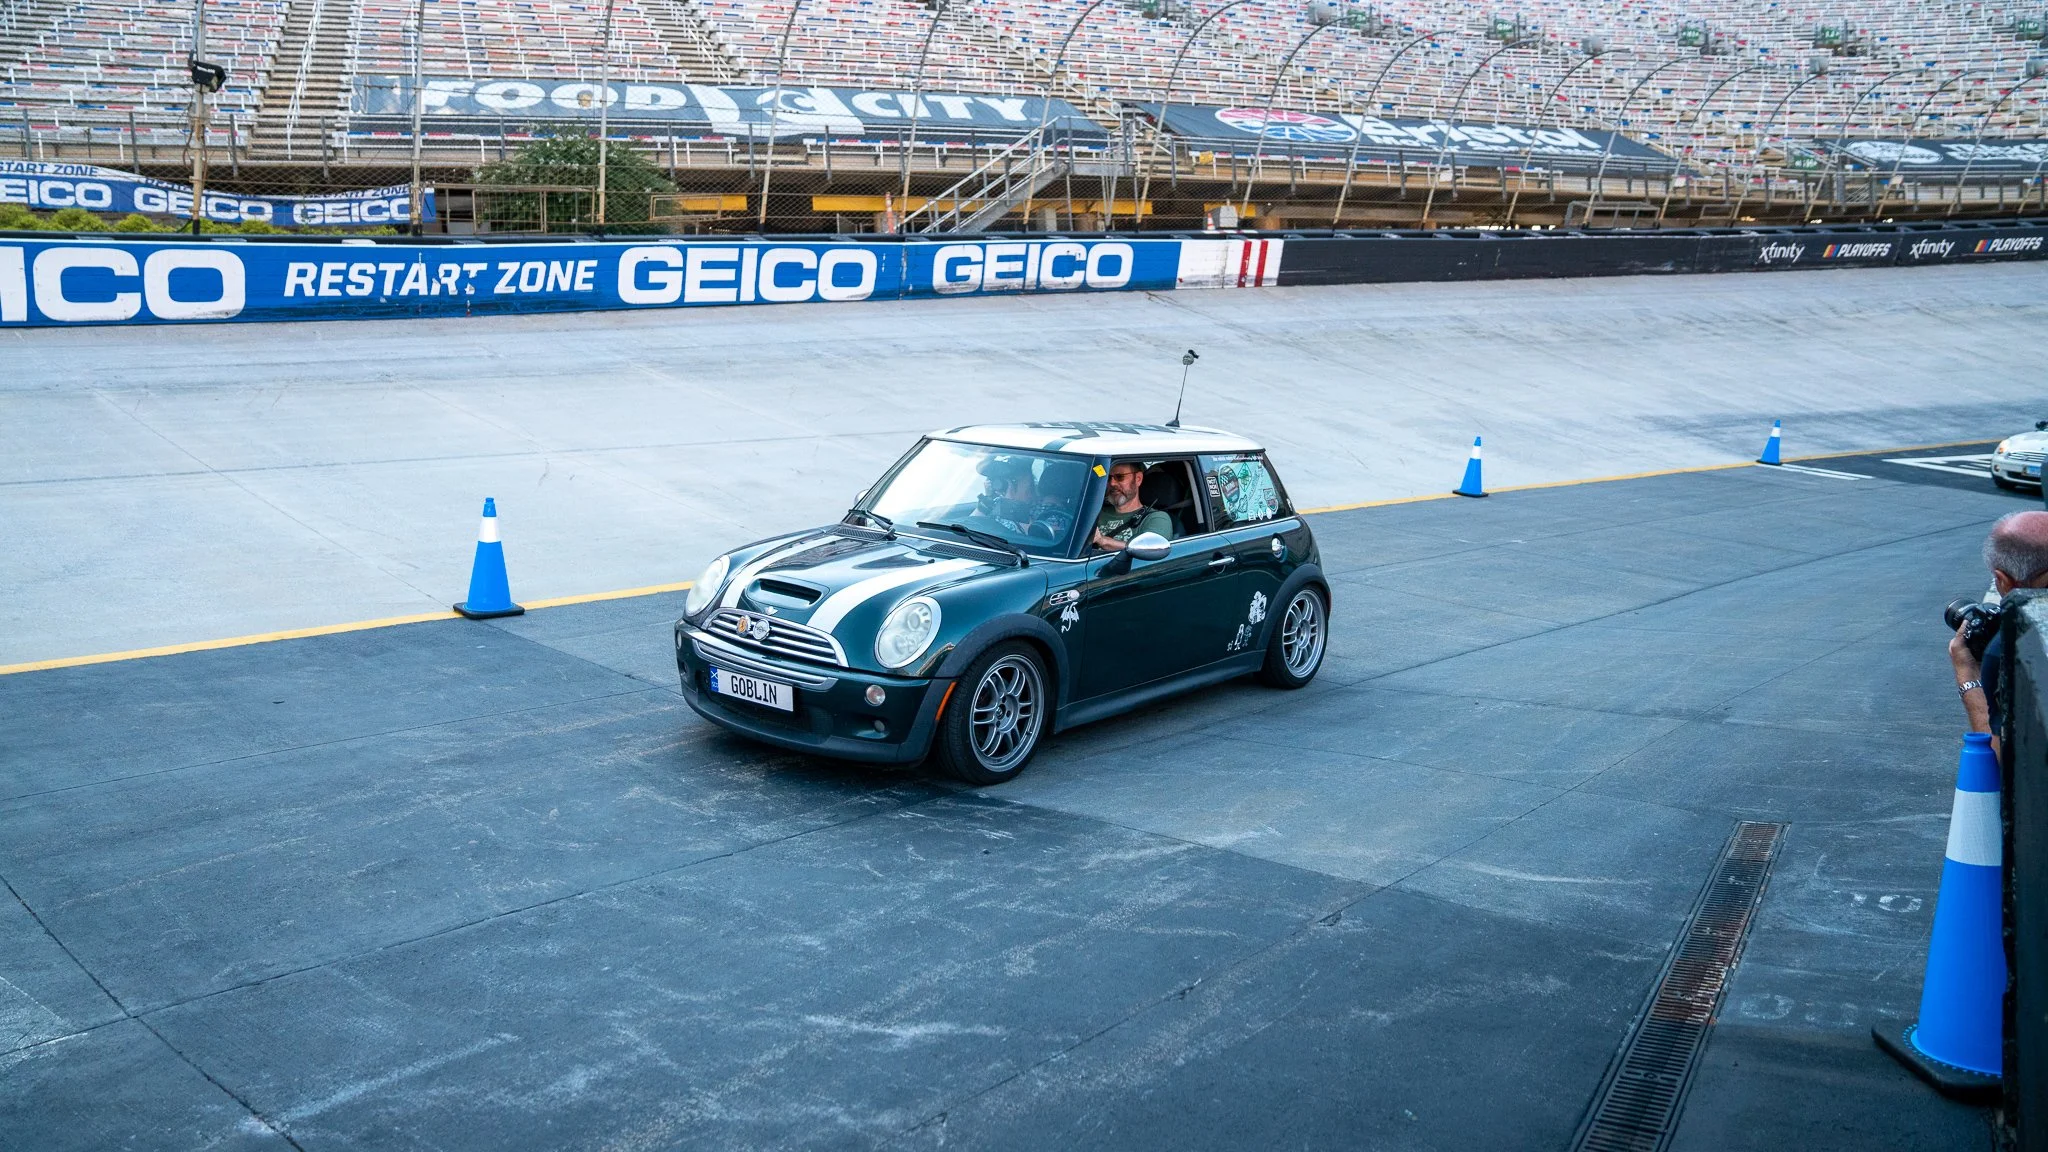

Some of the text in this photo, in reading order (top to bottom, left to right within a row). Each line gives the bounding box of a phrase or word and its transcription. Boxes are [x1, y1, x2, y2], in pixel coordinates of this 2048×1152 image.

[421, 80, 1028, 122] FOOD CITY
[1341, 115, 1602, 149] Bristol
[52, 164, 99, 177] ZONE
[1758, 241, 1891, 263] xfinity PLAYOFFS
[1909, 236, 2044, 259] xfinity PLAYOFFS
[284, 262, 487, 297] RESTART
[494, 259, 597, 294] ZONE
[618, 247, 877, 303] GEICO
[933, 243, 1134, 295] GEICO
[731, 674, 777, 705] GOBLIN
